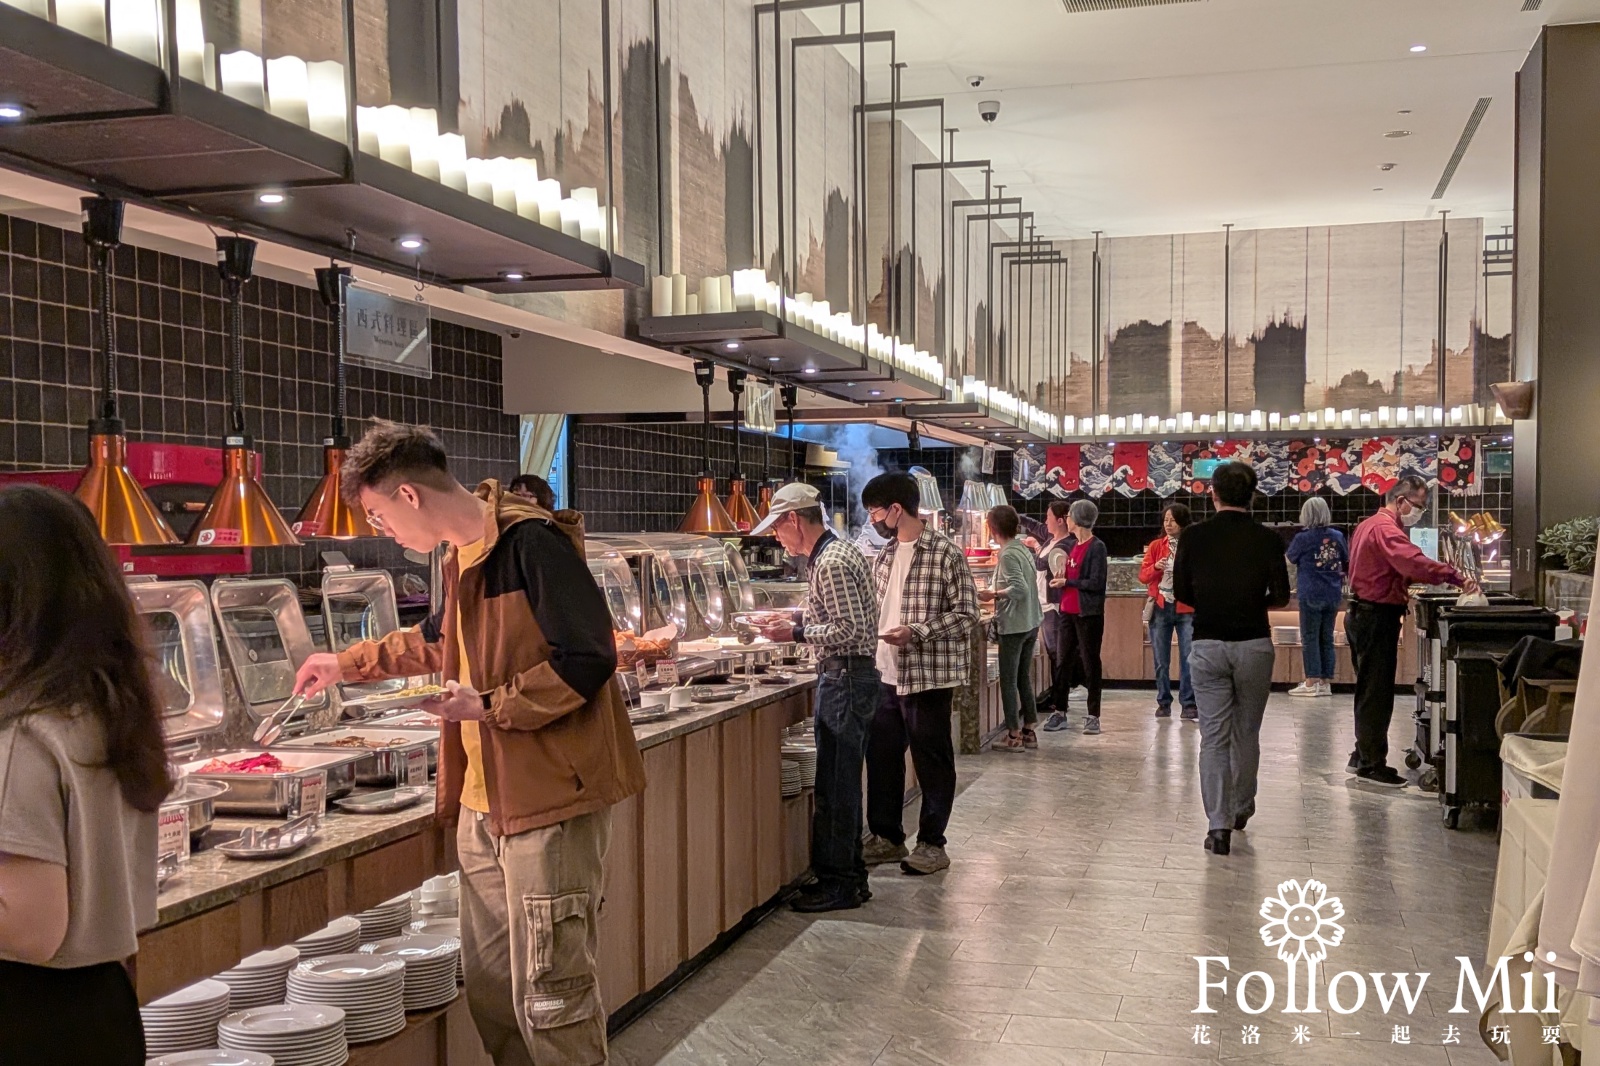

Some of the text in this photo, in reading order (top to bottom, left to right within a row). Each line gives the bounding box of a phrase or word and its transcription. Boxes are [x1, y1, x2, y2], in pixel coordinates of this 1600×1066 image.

[357, 308, 419, 339] 西式料理區
